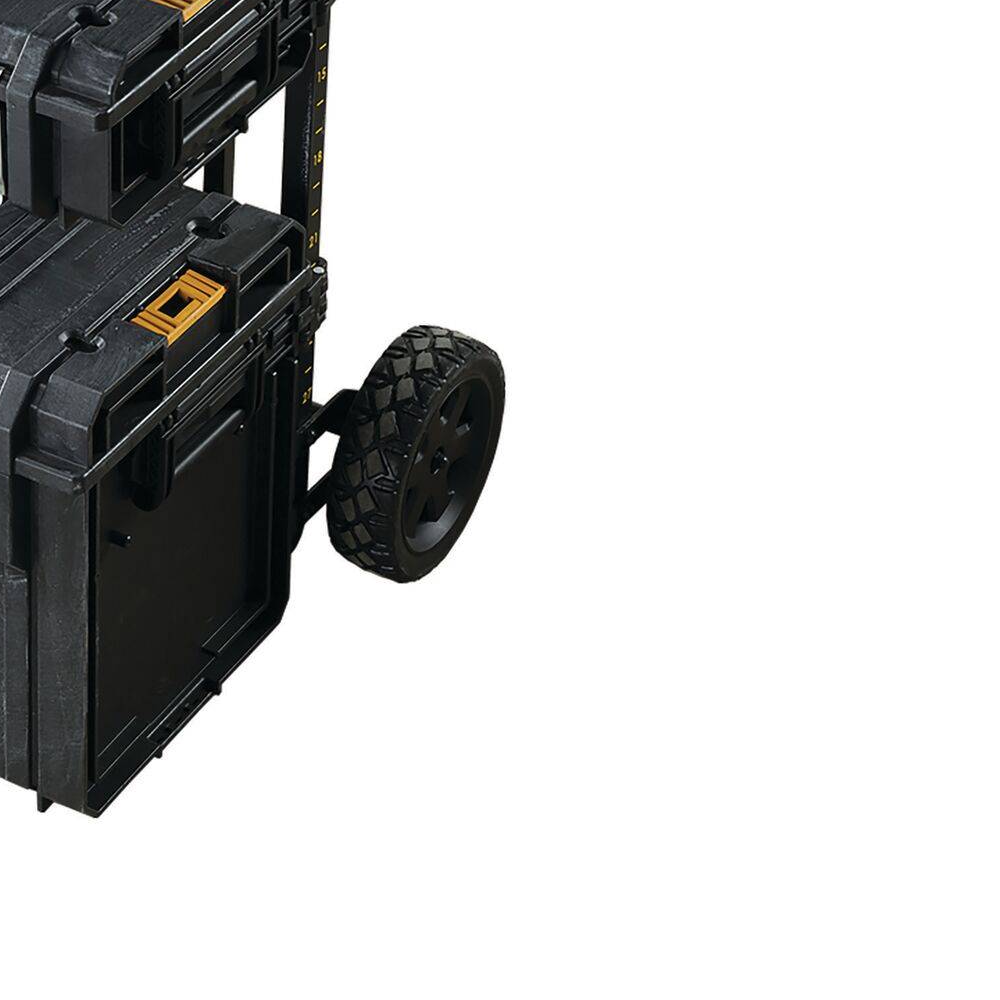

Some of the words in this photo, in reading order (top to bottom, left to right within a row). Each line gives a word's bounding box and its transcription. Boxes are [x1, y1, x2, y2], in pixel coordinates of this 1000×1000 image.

[317, 65, 327, 83] 15
[313, 150, 323, 166] 18
[308, 232, 318, 248] 21
